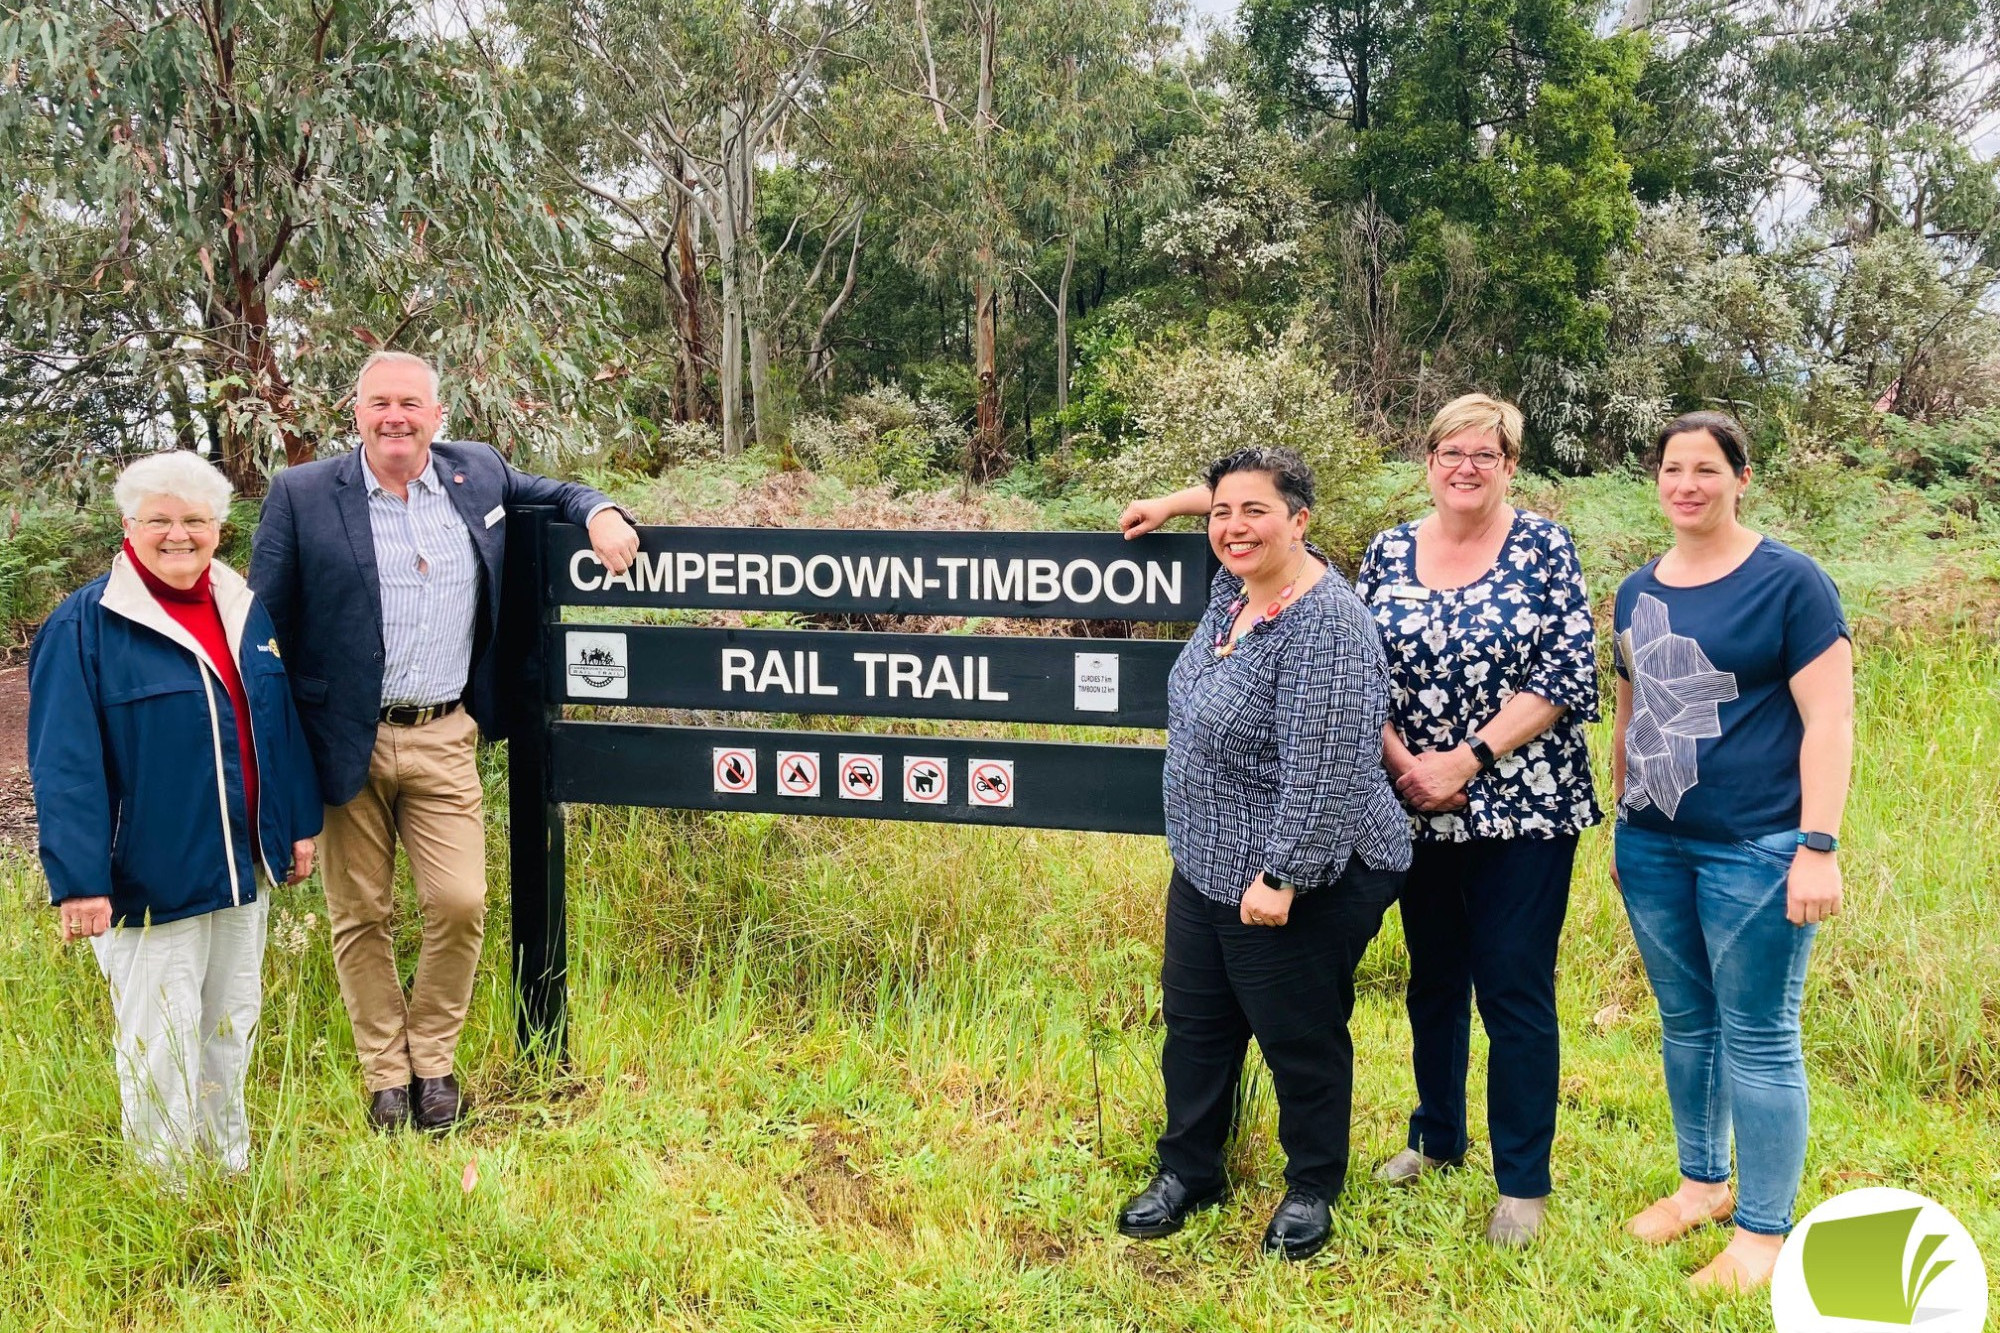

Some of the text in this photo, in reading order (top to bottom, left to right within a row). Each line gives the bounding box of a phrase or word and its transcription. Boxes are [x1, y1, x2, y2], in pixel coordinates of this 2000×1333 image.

[568, 548, 1182, 606] CAMPERDOWN-TIMBOON
[721, 648, 1009, 702] RAIL TRAIL
